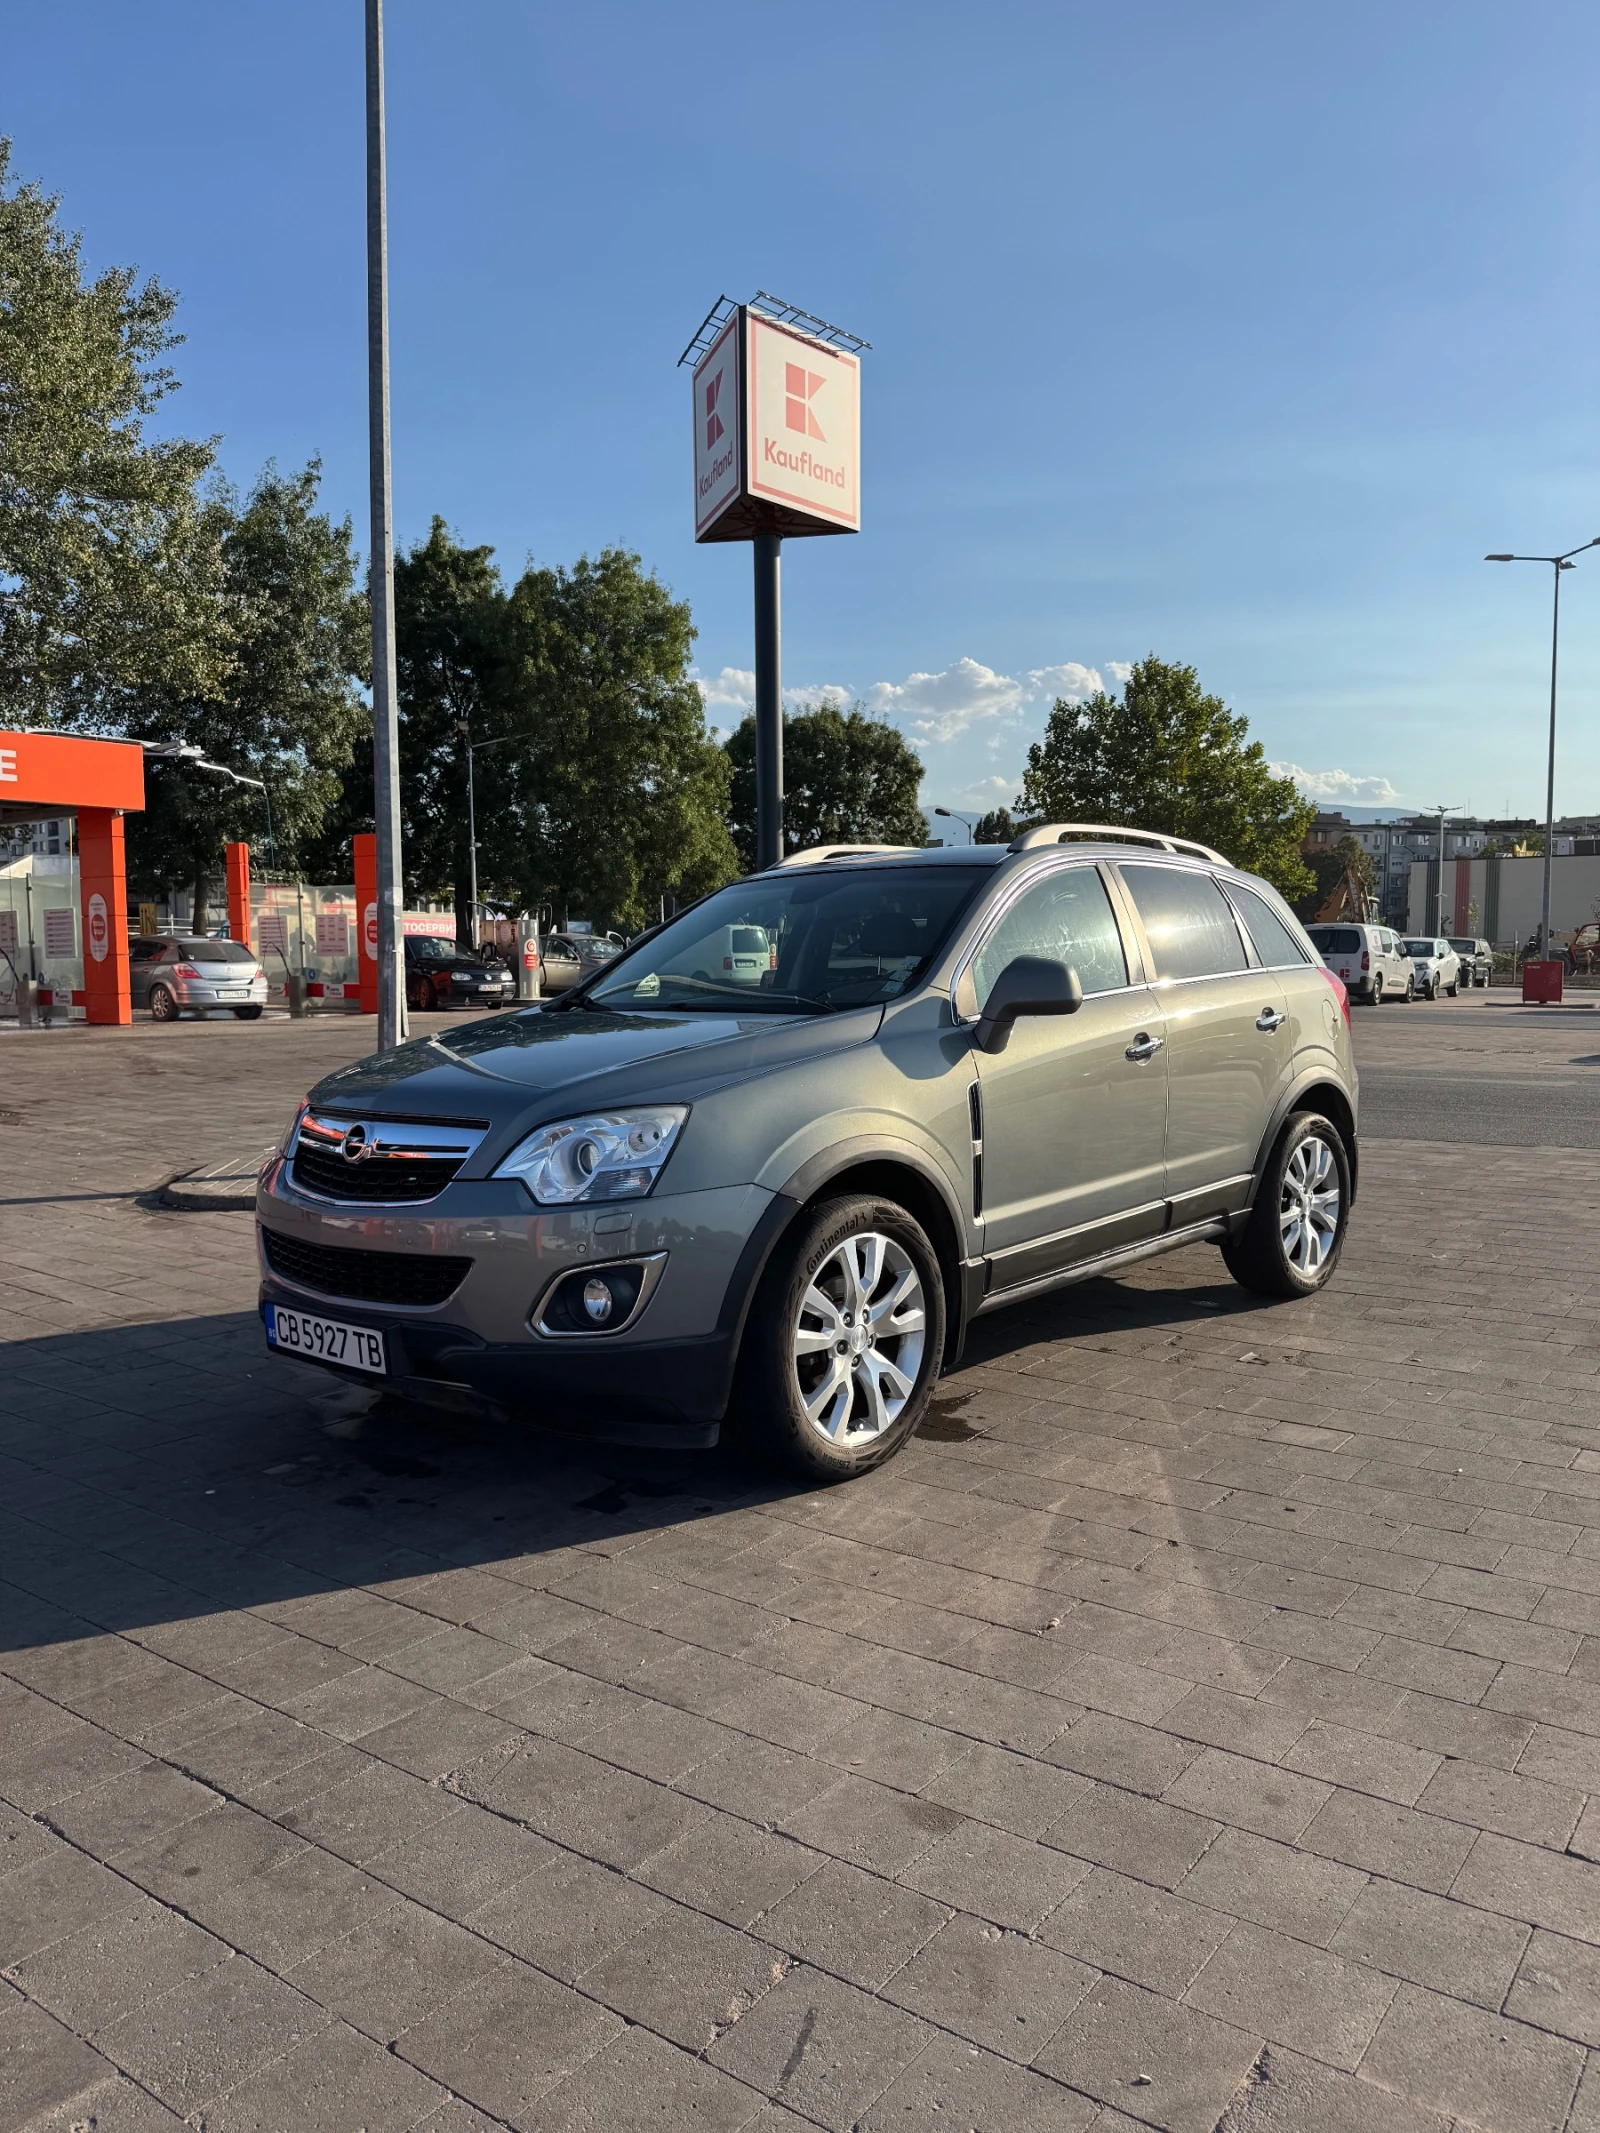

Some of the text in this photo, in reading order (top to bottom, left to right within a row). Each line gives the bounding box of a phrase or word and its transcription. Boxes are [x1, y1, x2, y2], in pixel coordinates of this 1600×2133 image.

[698, 441, 733, 500] Kaufland
[764, 437, 846, 490] Kaufland
[403, 922, 457, 933] ТОСЕРВИ
[806, 1214, 859, 1275] Continental
[269, 1328, 276, 1338] BG
[277, 1311, 382, 1368] CB 5927 TB
[828, 1456, 851, 1470] 235/50
